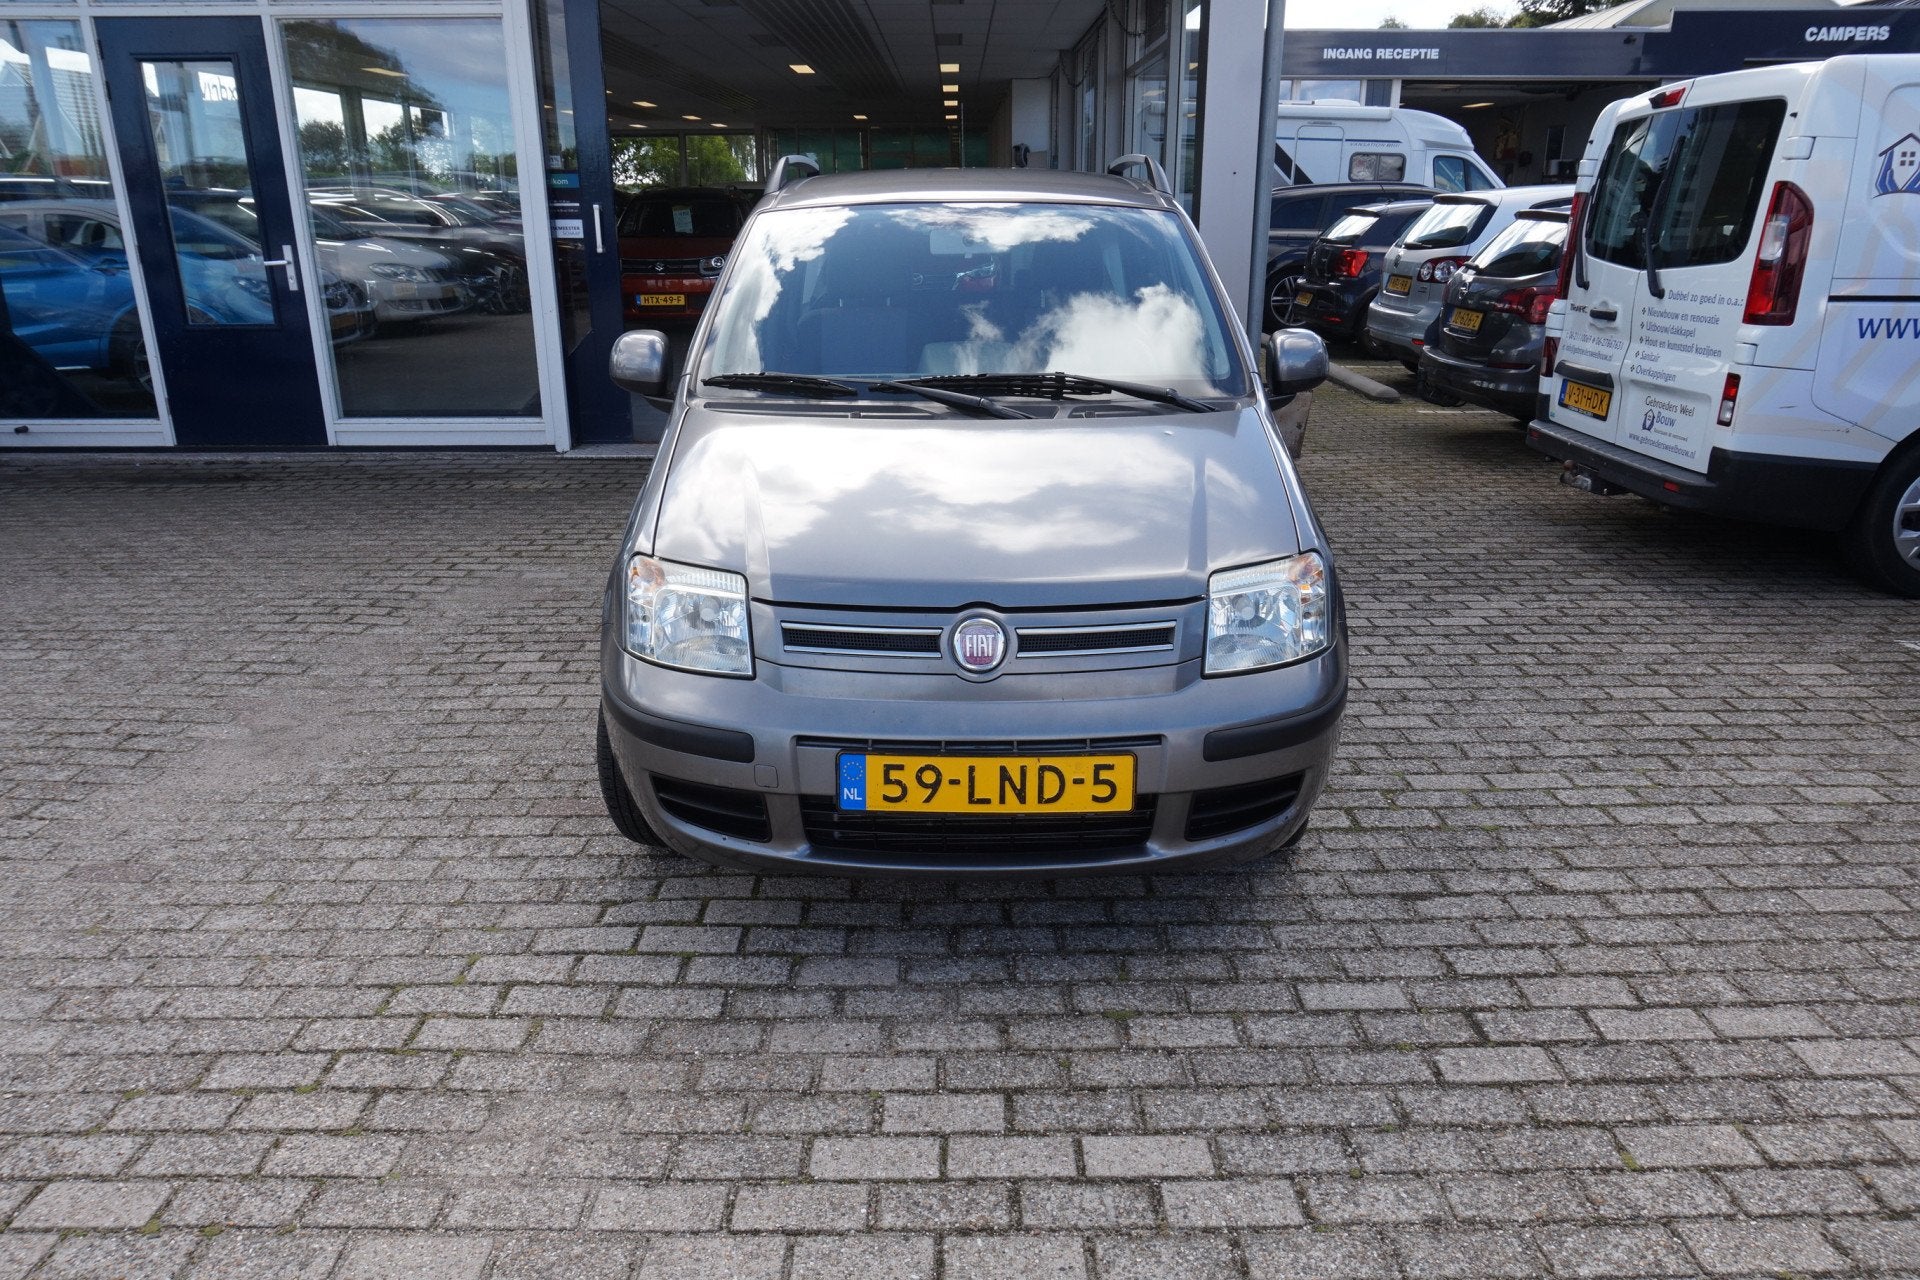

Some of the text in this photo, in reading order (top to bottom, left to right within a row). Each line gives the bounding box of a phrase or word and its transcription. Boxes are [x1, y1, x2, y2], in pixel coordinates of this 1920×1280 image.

[1805, 25, 1890, 42] CAMPERS
[1323, 48, 1440, 60] INGANG RECEPTIE
[643, 296, 682, 304] HTX-49-F
[1668, 289, 1690, 301] Dubbel
[1690, 294, 1699, 302] zo
[1699, 294, 1717, 305] goed
[1717, 294, 1726, 304] in
[1647, 306, 1720, 325] Nieuwbouw en renovatie
[1645, 336, 1722, 358] Hout en kunststof kozijnen
[1640, 351, 1660, 362] Sanitair
[1635, 365, 1677, 382] Overkappingen
[1568, 385, 1607, 412] V-31-HDK
[1645, 395, 1696, 417] Gebroeders Weel
[965, 634, 996, 657] FIAT
[844, 763, 1118, 805] NL 59-LND-5
